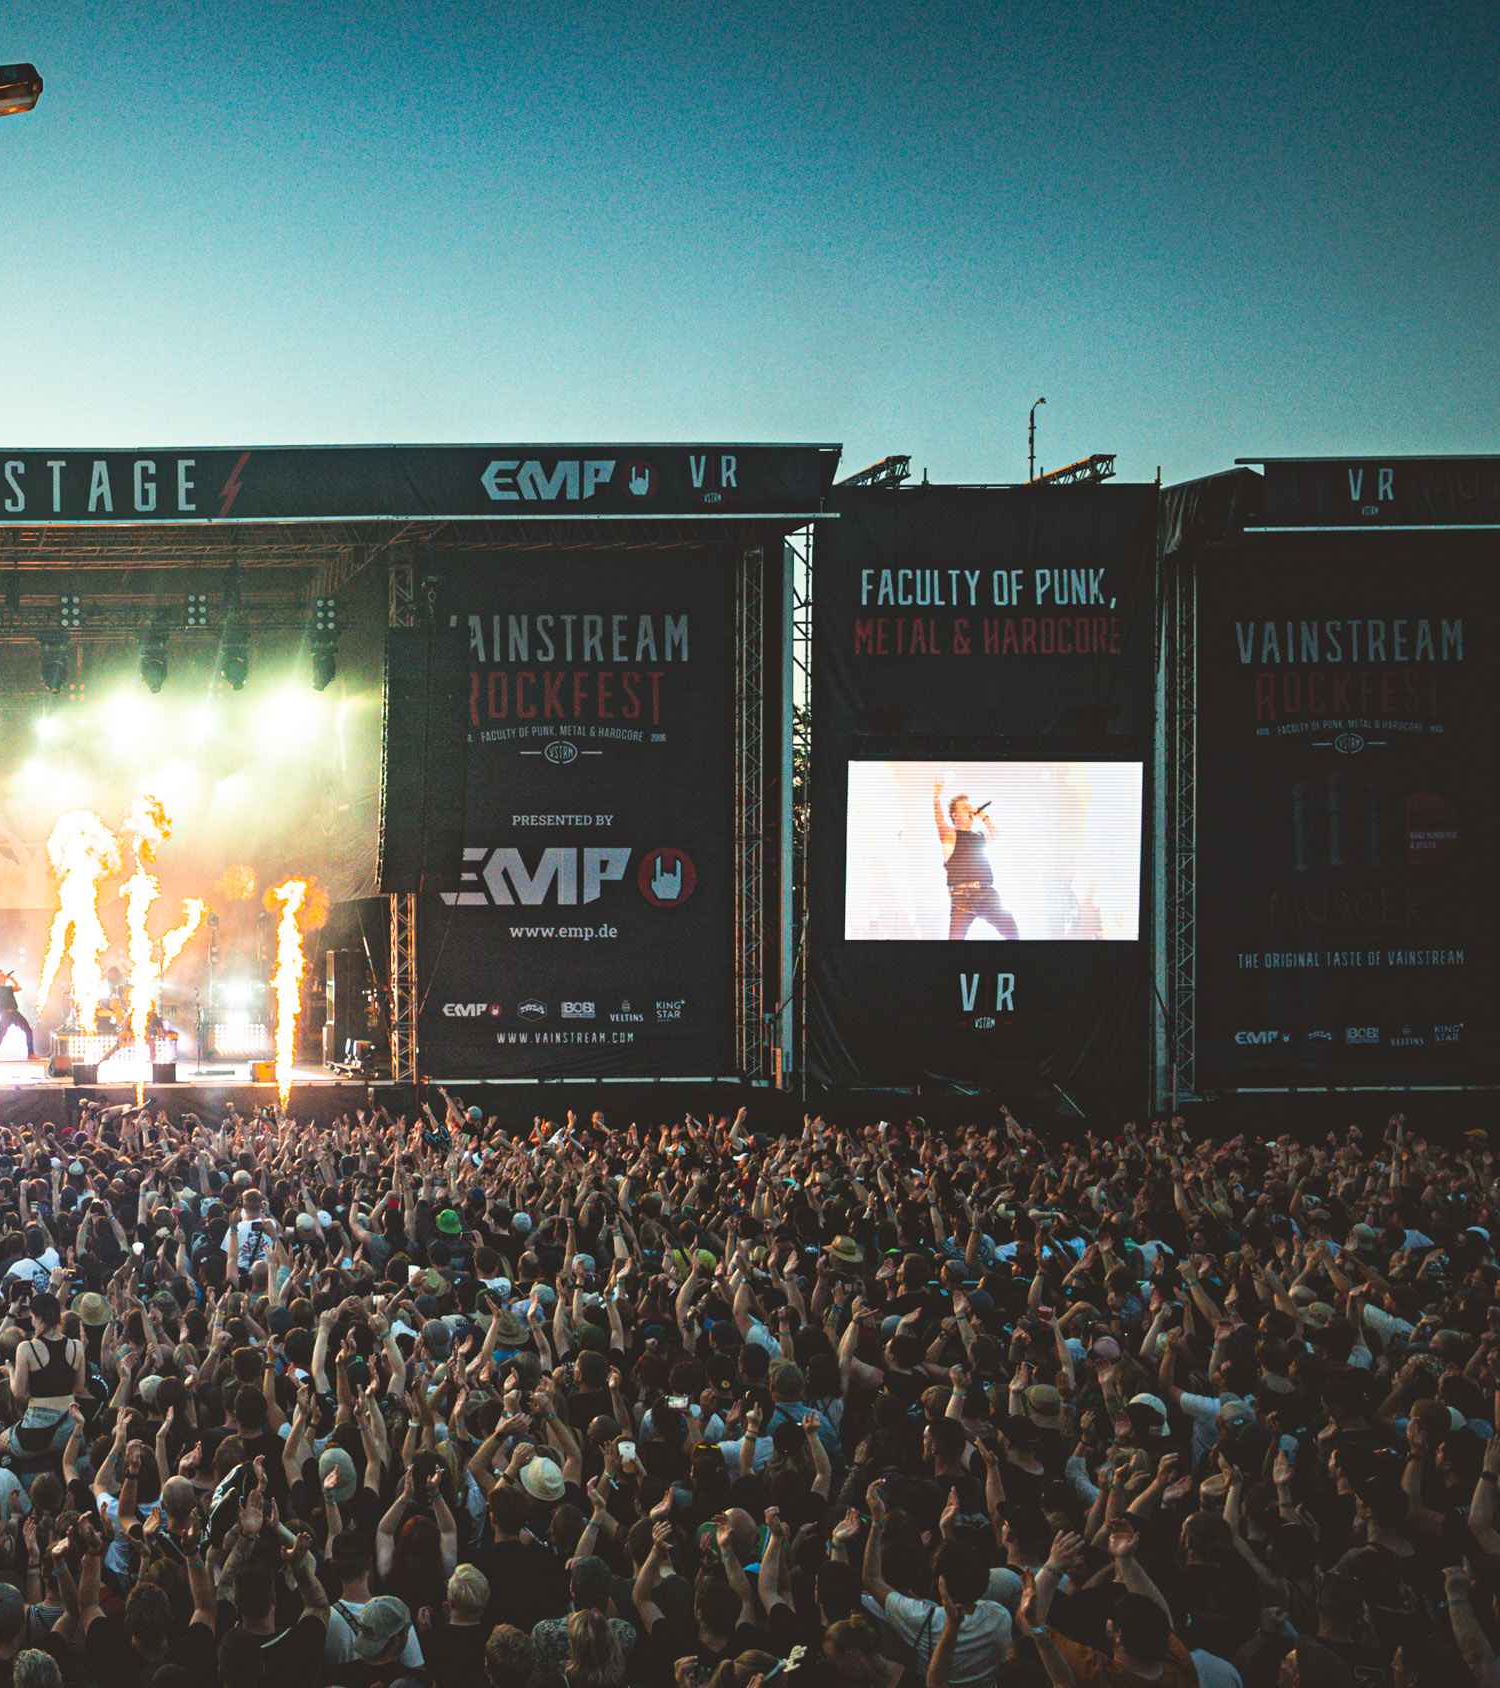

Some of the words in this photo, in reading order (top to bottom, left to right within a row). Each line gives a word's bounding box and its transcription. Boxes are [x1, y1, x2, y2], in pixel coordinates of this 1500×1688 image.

[4, 459, 196, 513] STAGE
[480, 460, 616, 500] EMP
[861, 568, 980, 606] FACULTY
[993, 570, 1024, 606] OF
[1035, 568, 1116, 609] PUNK,
[450, 614, 689, 662] AINSTREAM
[854, 618, 941, 656] METAL
[953, 619, 972, 656] &
[982, 616, 1122, 656] HARDCORE
[1236, 619, 1465, 664] VAINSTREAM
[480, 728, 516, 743] FACULTY
[519, 726, 530, 738] OF
[559, 725, 586, 737] METAL
[598, 727, 644, 743] HARDCORE
[512, 815, 592, 826] PRESENTED
[596, 815, 614, 826] BY
[440, 847, 632, 905] EMP
[509, 924, 618, 940] www.emp.de
[1238, 953, 1260, 969] THE
[1264, 952, 1320, 968] ORIGINAL
[1327, 952, 1362, 968] TASTE
[1367, 951, 1381, 967] OF
[1387, 950, 1466, 966] VAINSTREAM
[442, 1003, 487, 1017] EMP
[656, 1001, 682, 1010] KING
[656, 1010, 681, 1019] STAR
[610, 1013, 644, 1023] VELTINS
[496, 1032, 635, 1044] WWW.VAINSTREAM.COM
